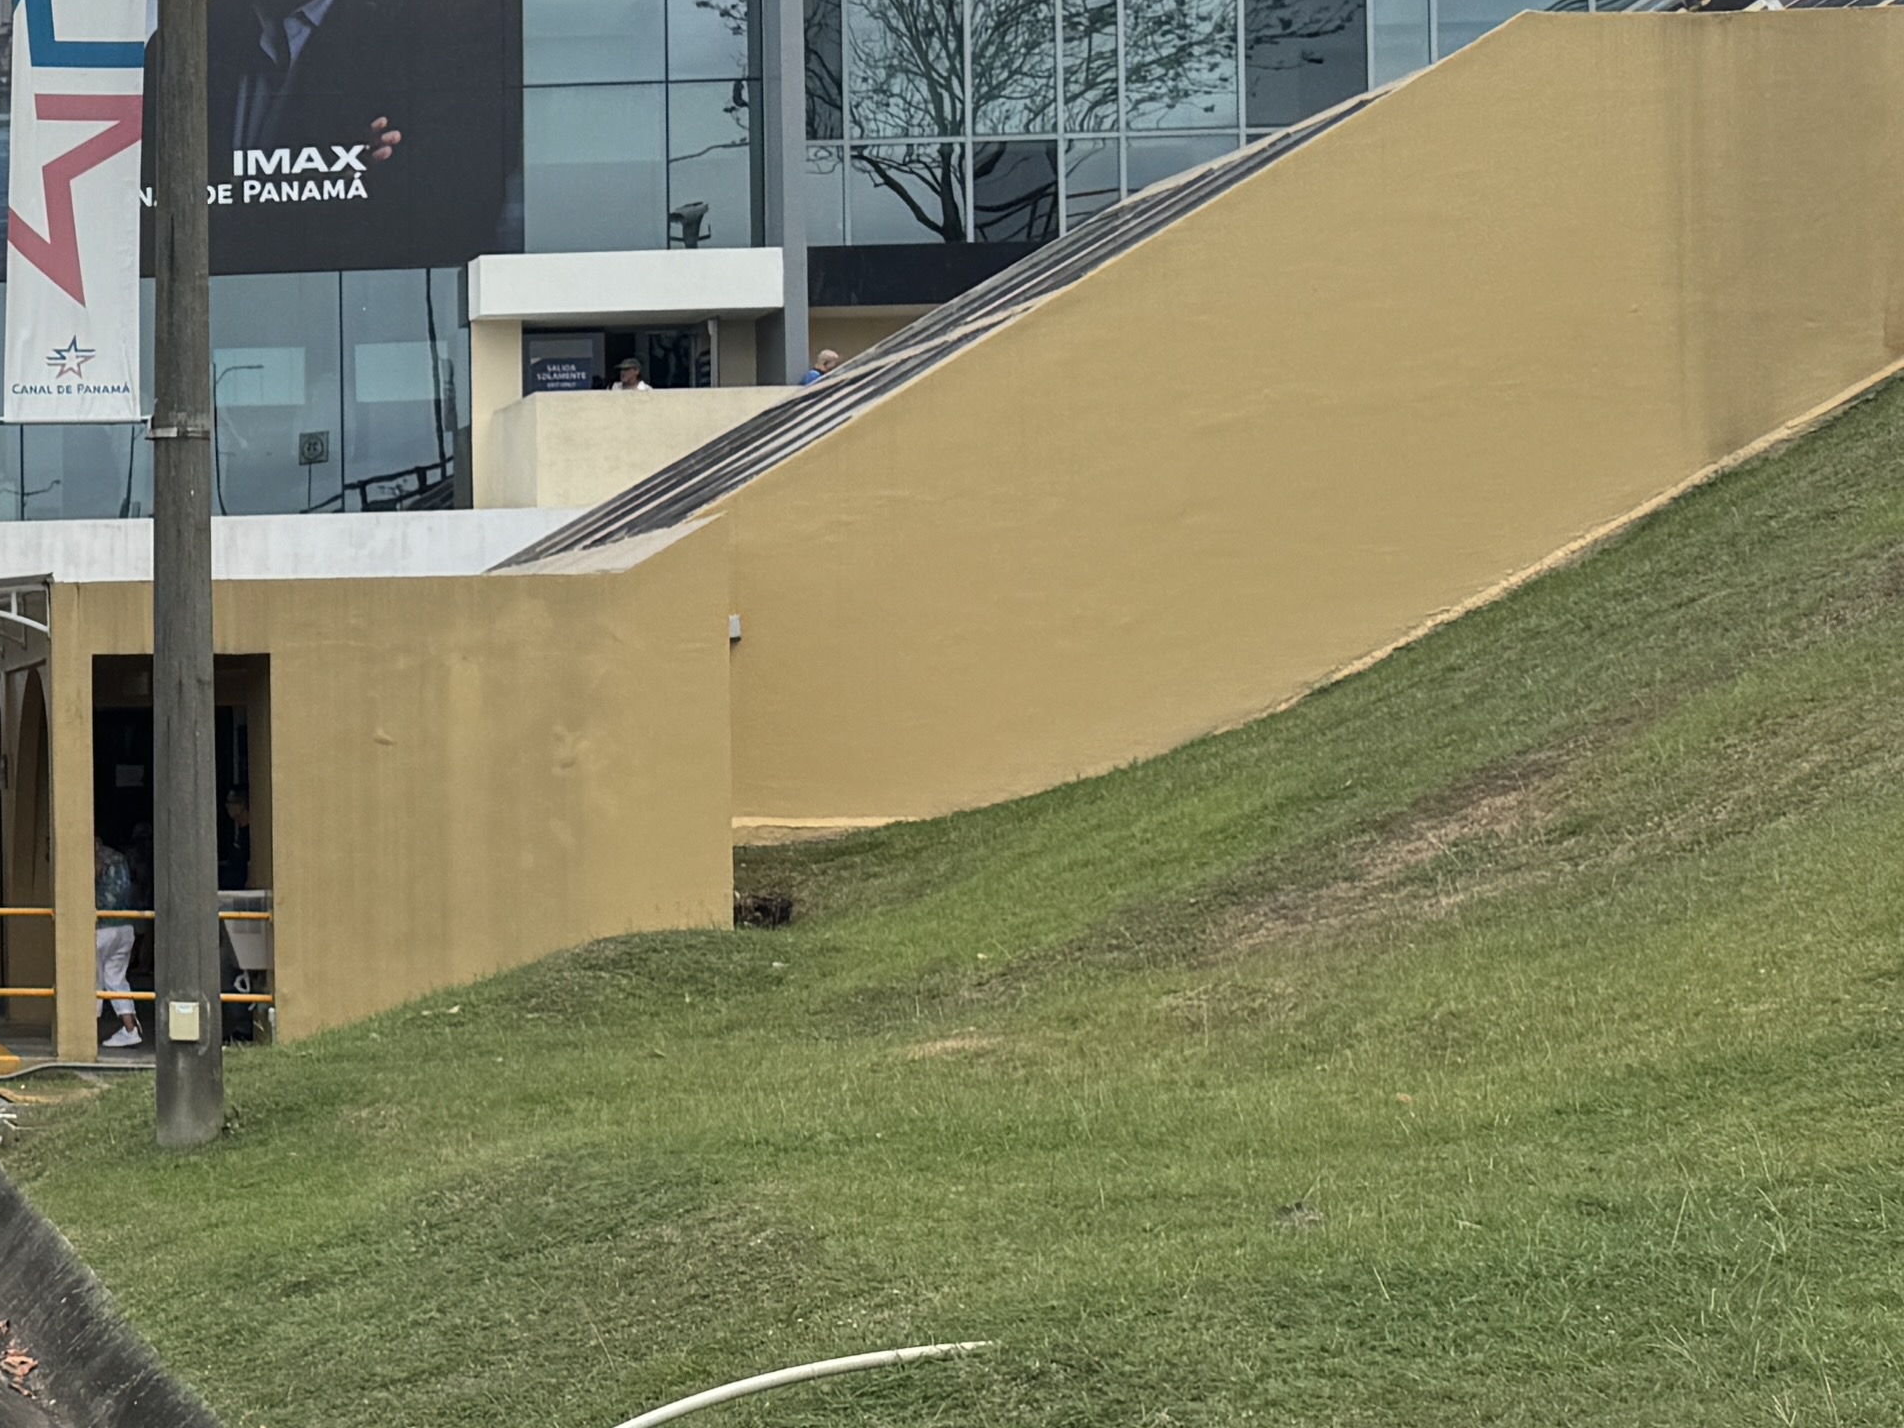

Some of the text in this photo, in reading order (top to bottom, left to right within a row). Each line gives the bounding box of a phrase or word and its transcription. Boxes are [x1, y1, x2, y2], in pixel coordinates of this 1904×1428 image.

[233, 145, 367, 176] IMAX
[244, 172, 368, 203] PANAMÁ
[12, 381, 131, 395] CANAL DE PANAMÁ
